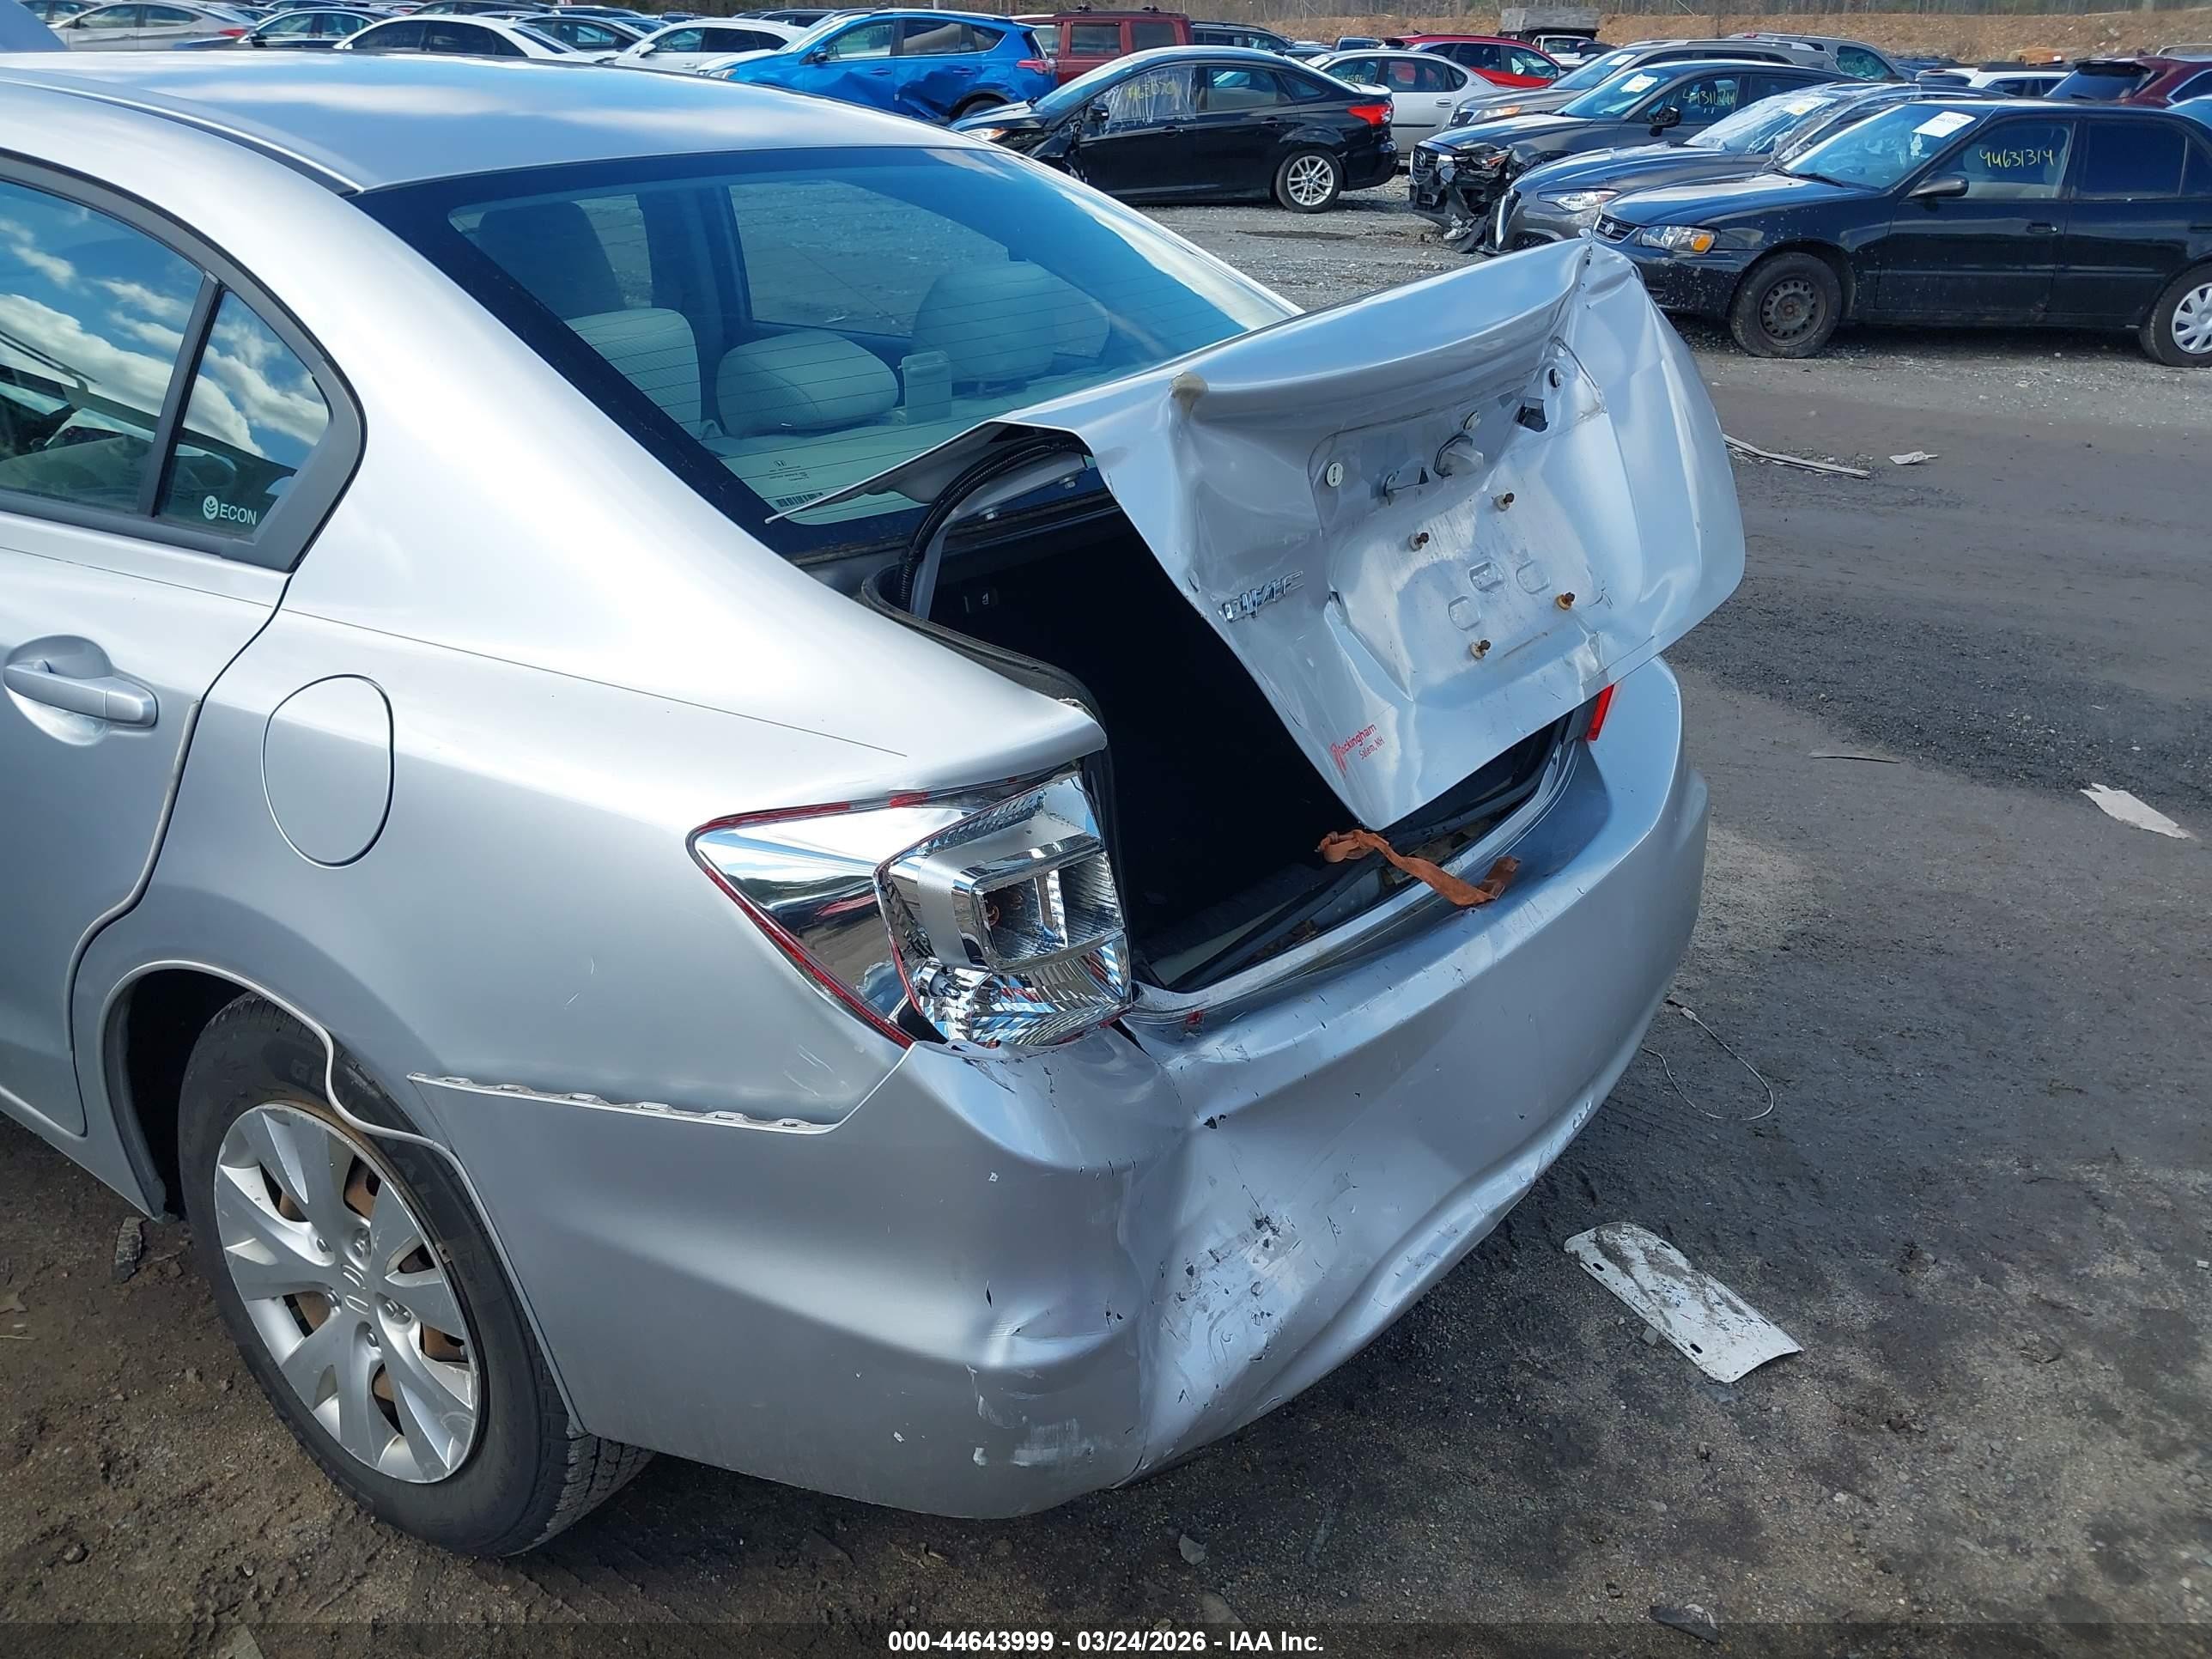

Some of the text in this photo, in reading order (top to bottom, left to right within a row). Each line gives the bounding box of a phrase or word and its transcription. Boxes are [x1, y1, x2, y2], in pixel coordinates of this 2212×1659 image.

[1978, 148, 2054, 168] 44631314
[219, 502, 257, 526] ECON
[1374, 736, 1385, 750] NH
